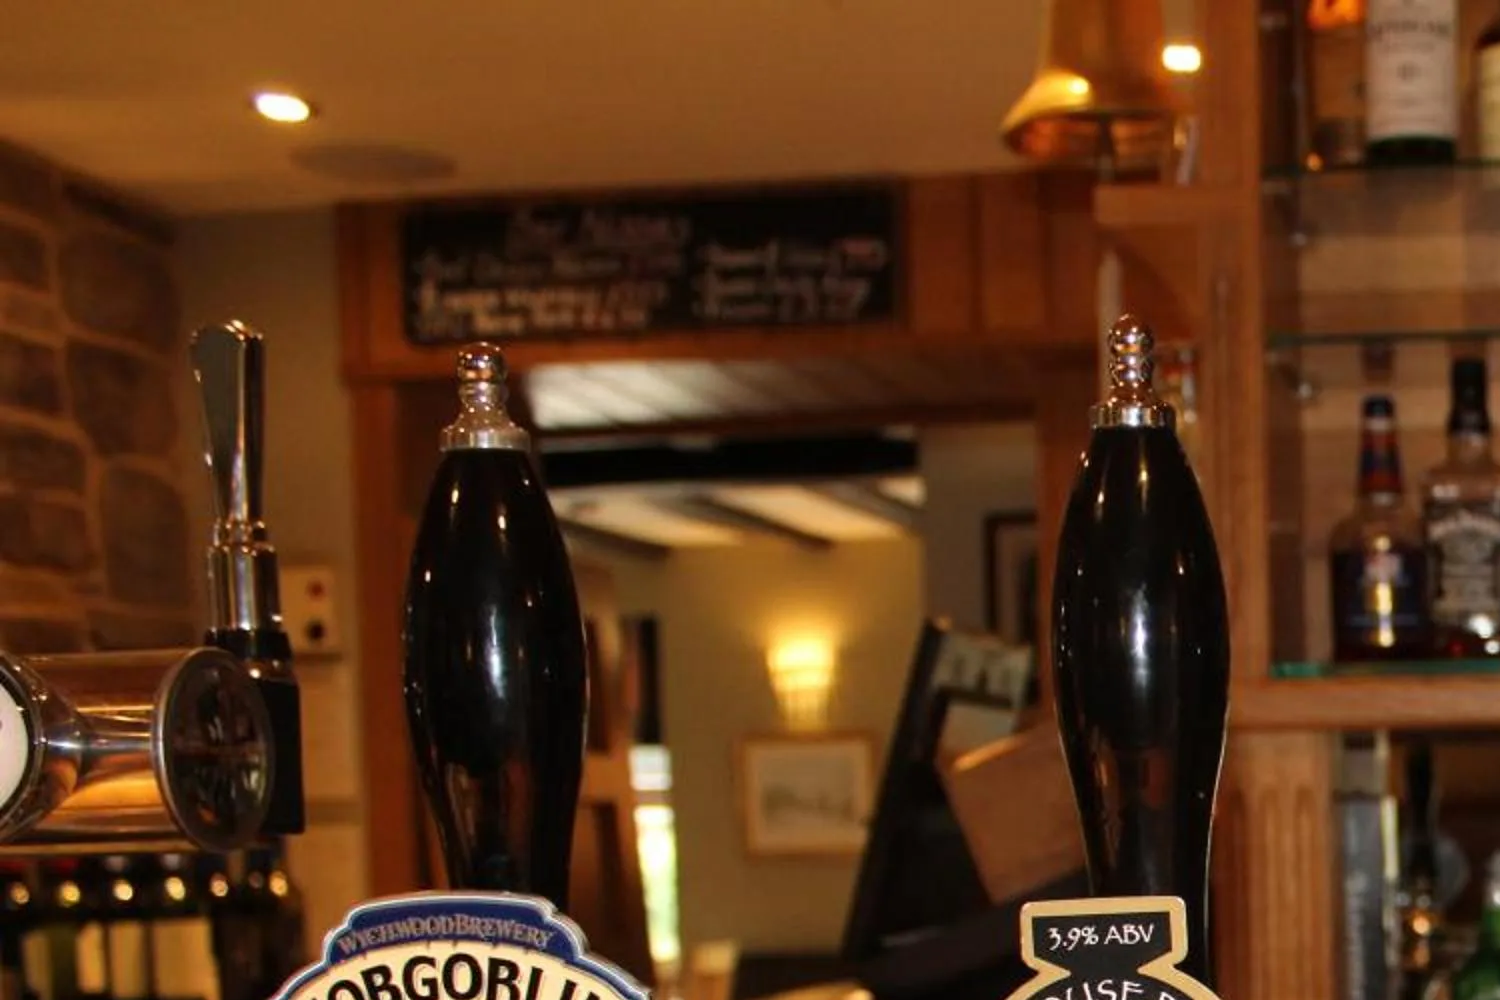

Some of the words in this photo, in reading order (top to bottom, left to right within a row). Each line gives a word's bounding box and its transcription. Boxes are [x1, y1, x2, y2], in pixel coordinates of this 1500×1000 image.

[453, 912, 554, 949] BREWERY
[1047, 925, 1100, 950] 3.9%
[1103, 923, 1155, 945] ABV
